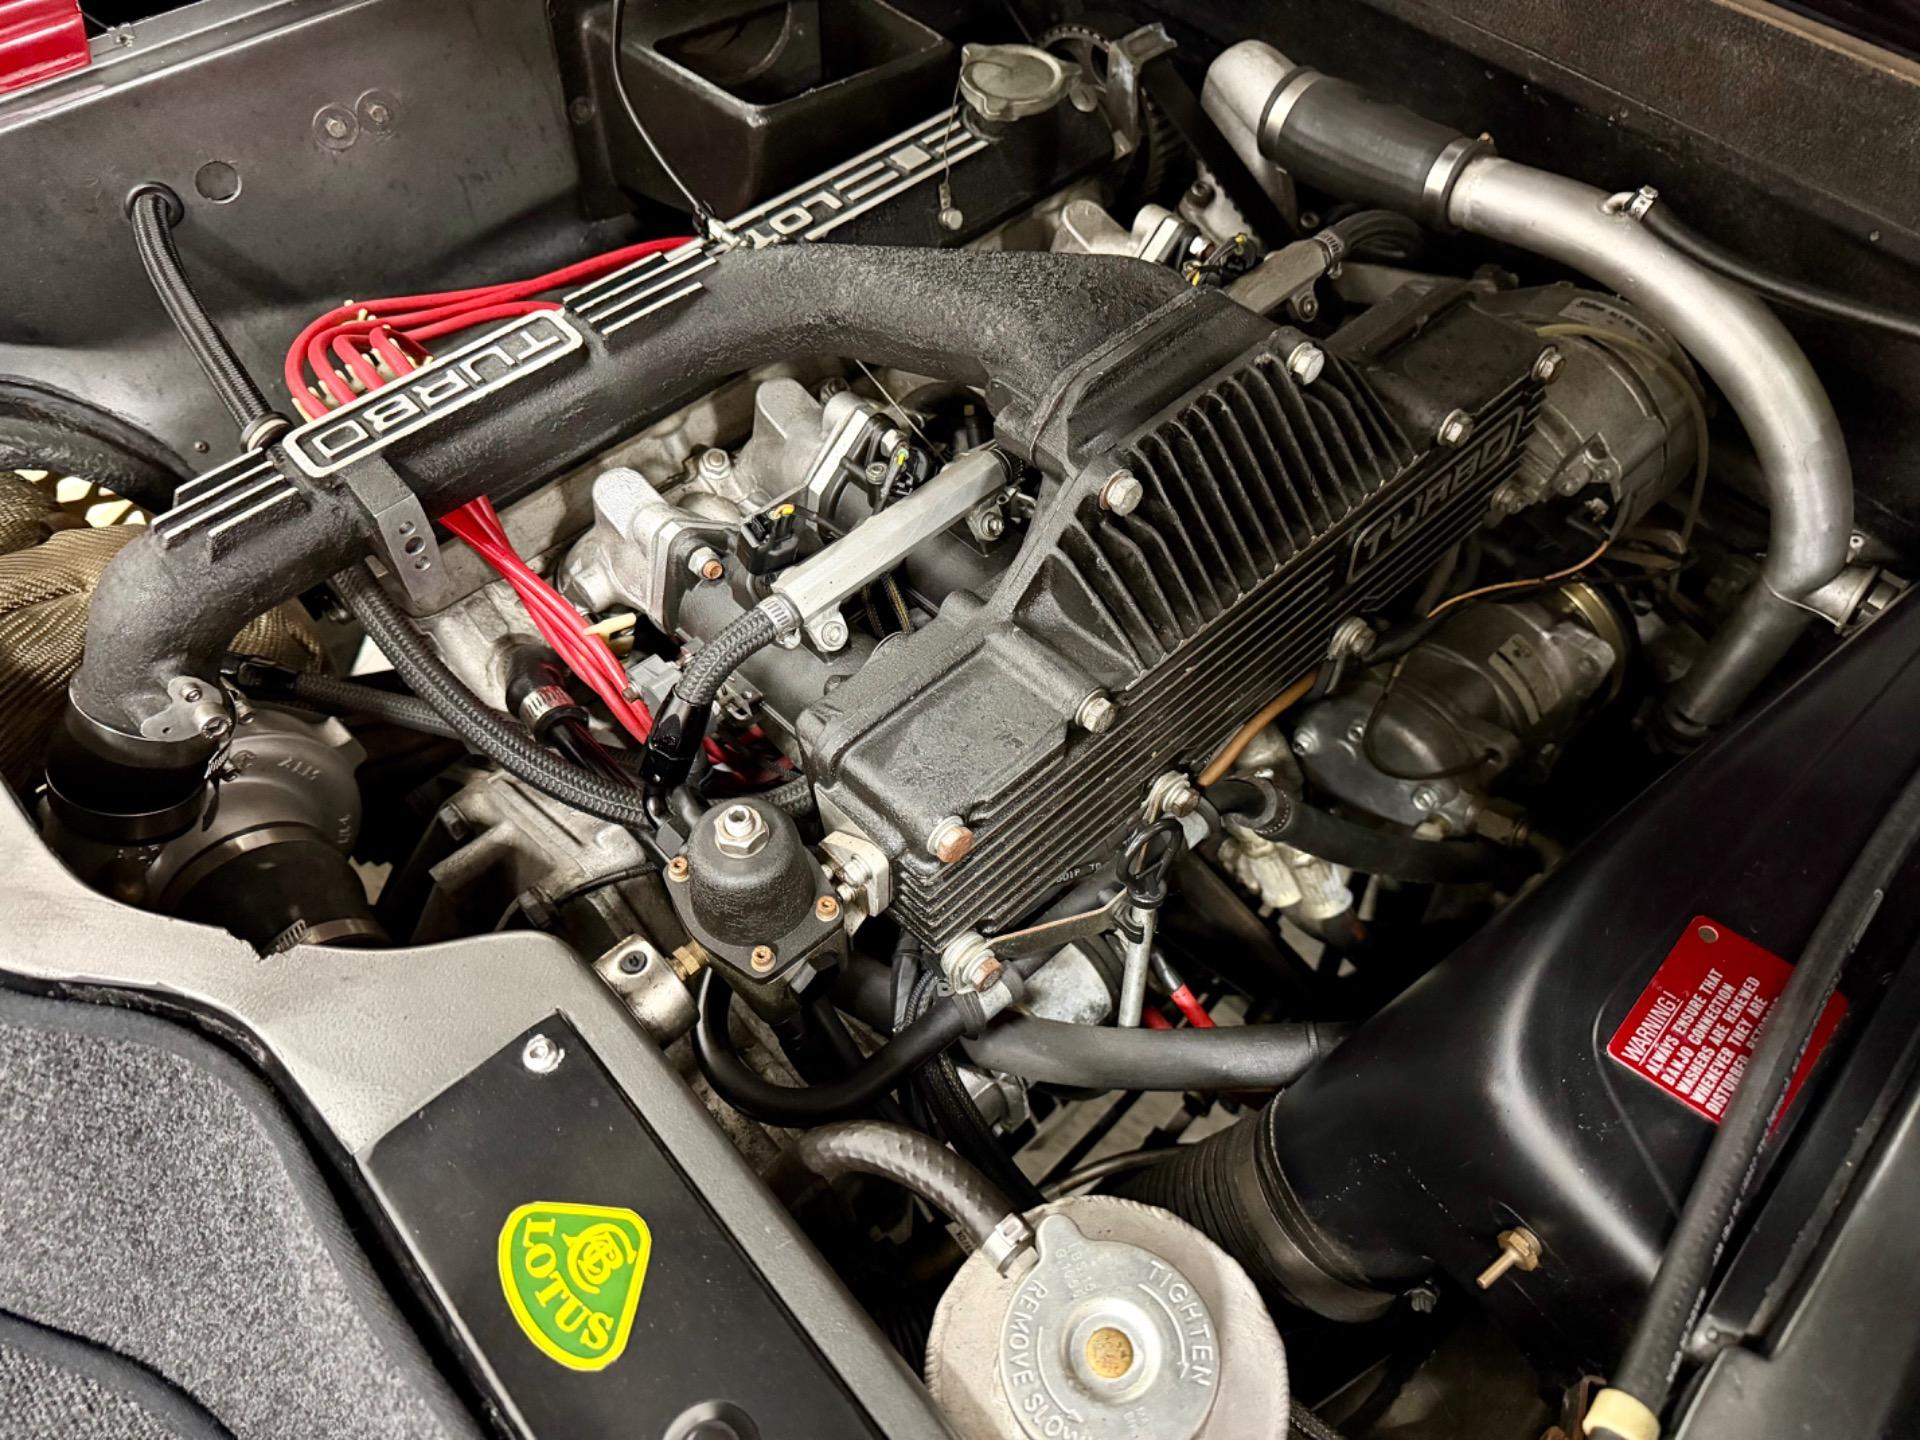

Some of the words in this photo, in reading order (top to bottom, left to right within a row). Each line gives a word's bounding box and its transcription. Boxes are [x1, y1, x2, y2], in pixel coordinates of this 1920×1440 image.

[744, 190, 843, 250] LOT
[311, 330, 561, 459] TURBO
[1362, 424, 1514, 562] TURBO
[1621, 990, 1681, 1063] WARNING!
[1645, 1034, 1680, 1077] ALWAYS
[1671, 993, 1707, 1036] ENSURE
[1698, 967, 1723, 995] THAT
[1660, 1045, 1694, 1087] BANJO
[1686, 982, 1736, 1046] CONNECTION
[1674, 1045, 1716, 1095] WASHERS
[1708, 1022, 1729, 1046] ARE
[1722, 976, 1760, 1024] RENEWED
[1690, 1046, 1736, 1105] WHENEVER
[1726, 1017, 1753, 1047] THEY
[1746, 995, 1768, 1018] ARE
[522, 1217, 614, 1350] LOTUS
[1008, 1279, 1048, 1388] REMOVE
[1149, 1260, 1213, 1387] TIGHTEN
